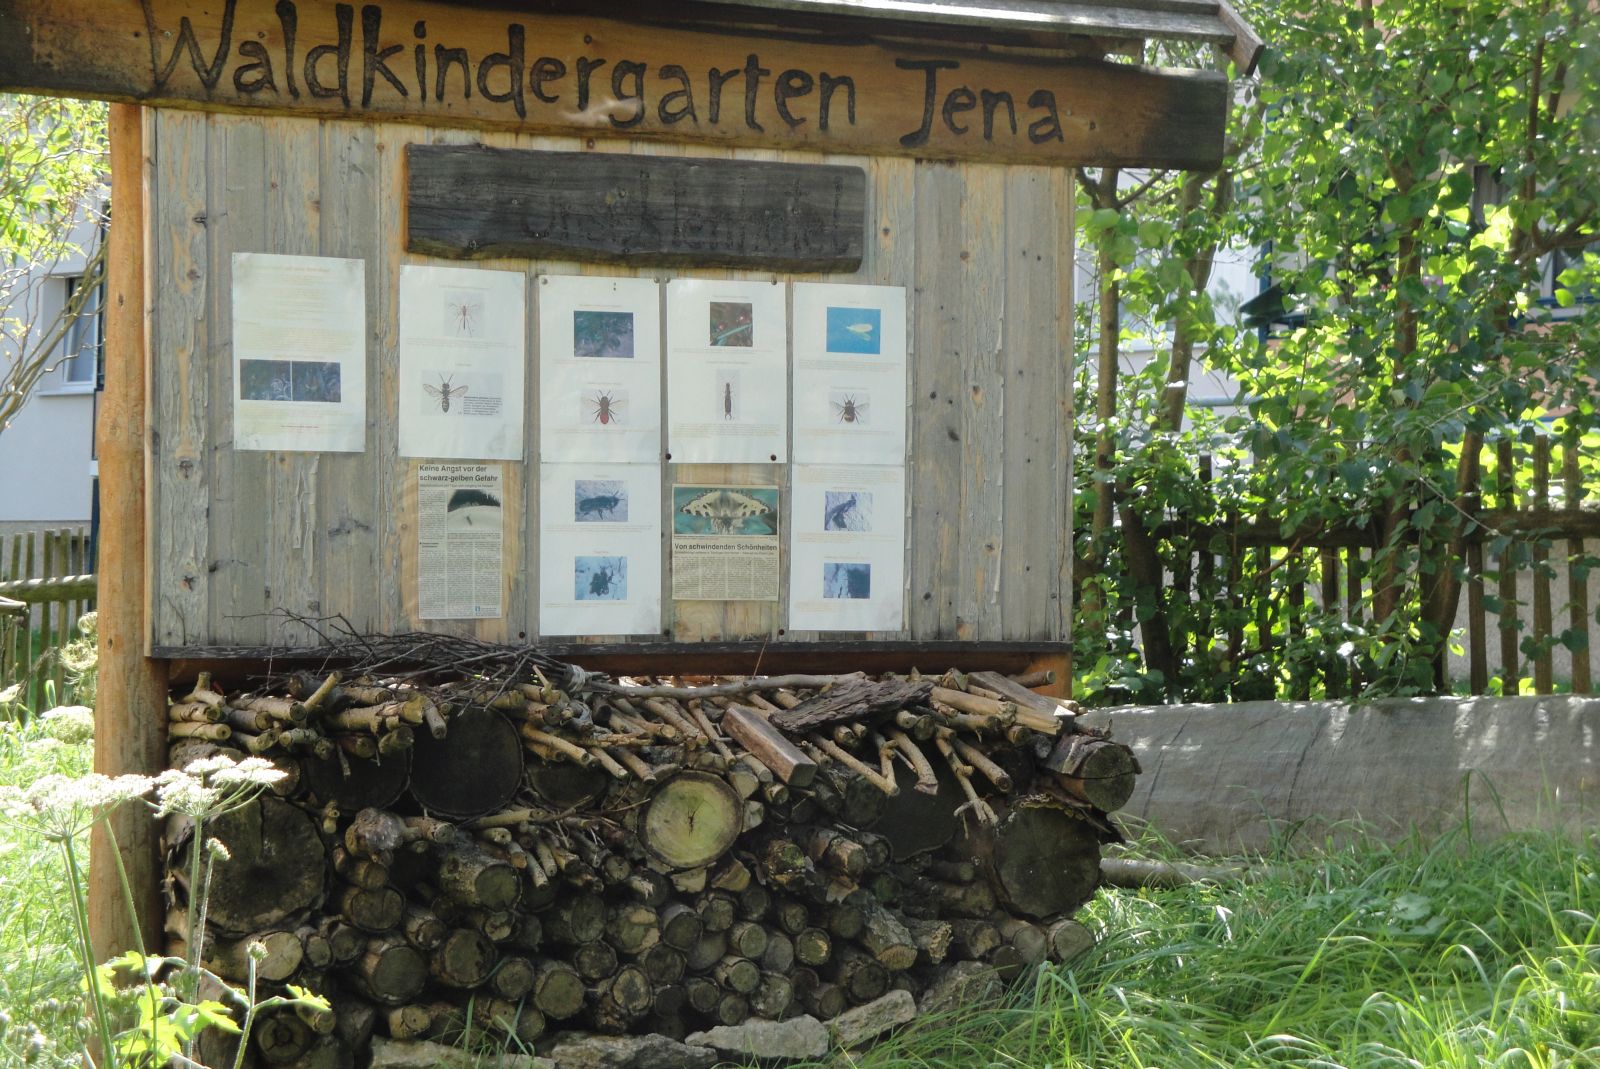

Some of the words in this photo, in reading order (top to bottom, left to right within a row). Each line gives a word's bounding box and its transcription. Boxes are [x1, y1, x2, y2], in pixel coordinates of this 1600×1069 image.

[142, 0, 857, 132] Waldkindergarten
[895, 58, 1065, 146] Jena
[440, 465, 462, 473] Angst
[419, 475, 474, 483] schwarz-gelben
[736, 543, 778, 551] Schönheiten
